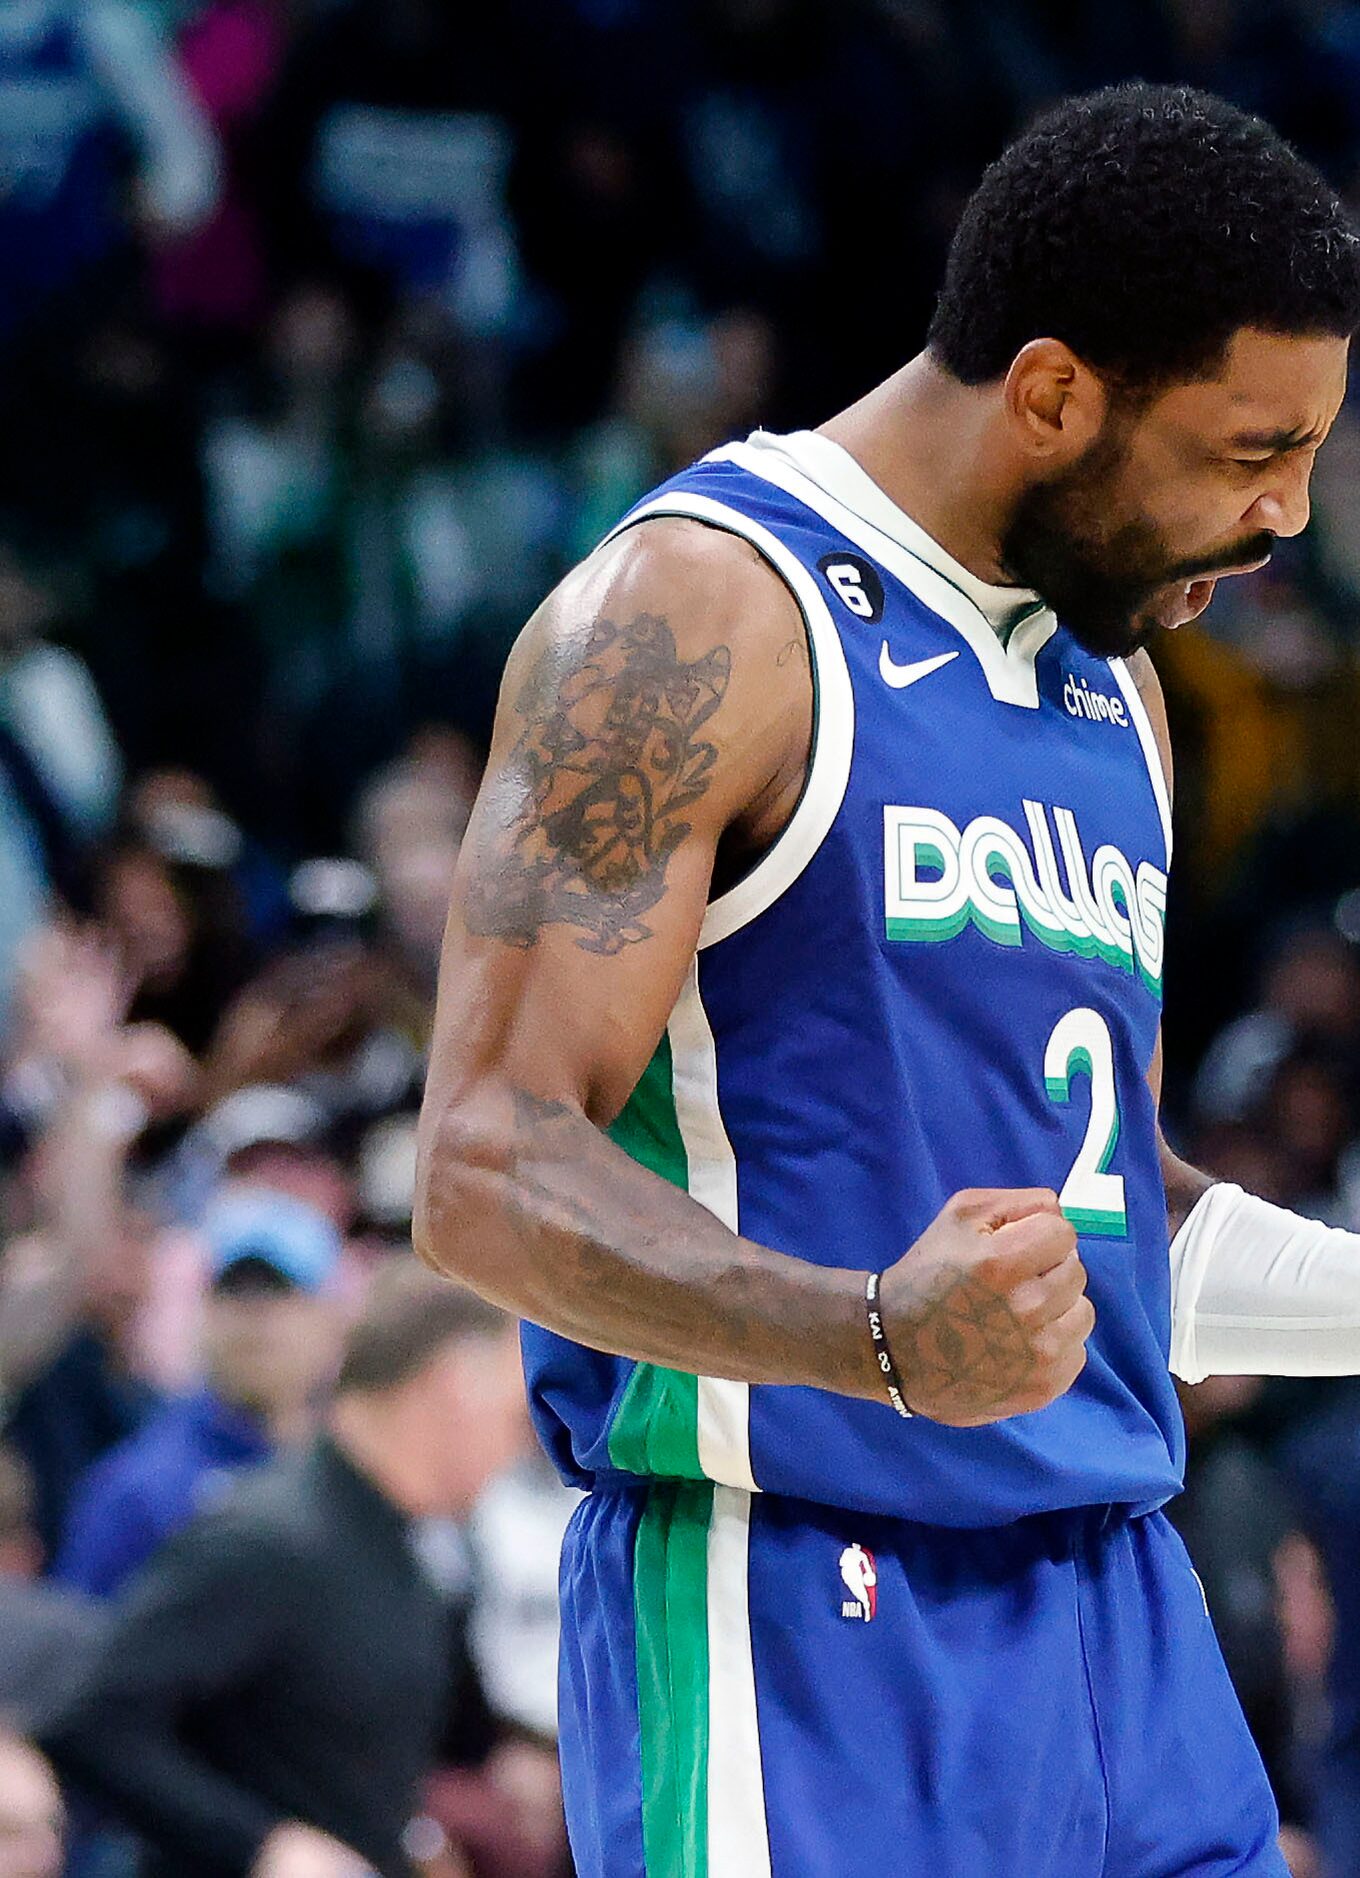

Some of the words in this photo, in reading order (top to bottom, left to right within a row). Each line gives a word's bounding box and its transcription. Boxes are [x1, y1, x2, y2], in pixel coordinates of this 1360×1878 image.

[826, 564, 874, 619] 6
[1063, 673, 1129, 728] chime
[883, 799, 1168, 1000] Dallas
[1044, 1007, 1128, 1238] 2
[841, 1601, 863, 1618] NBA
